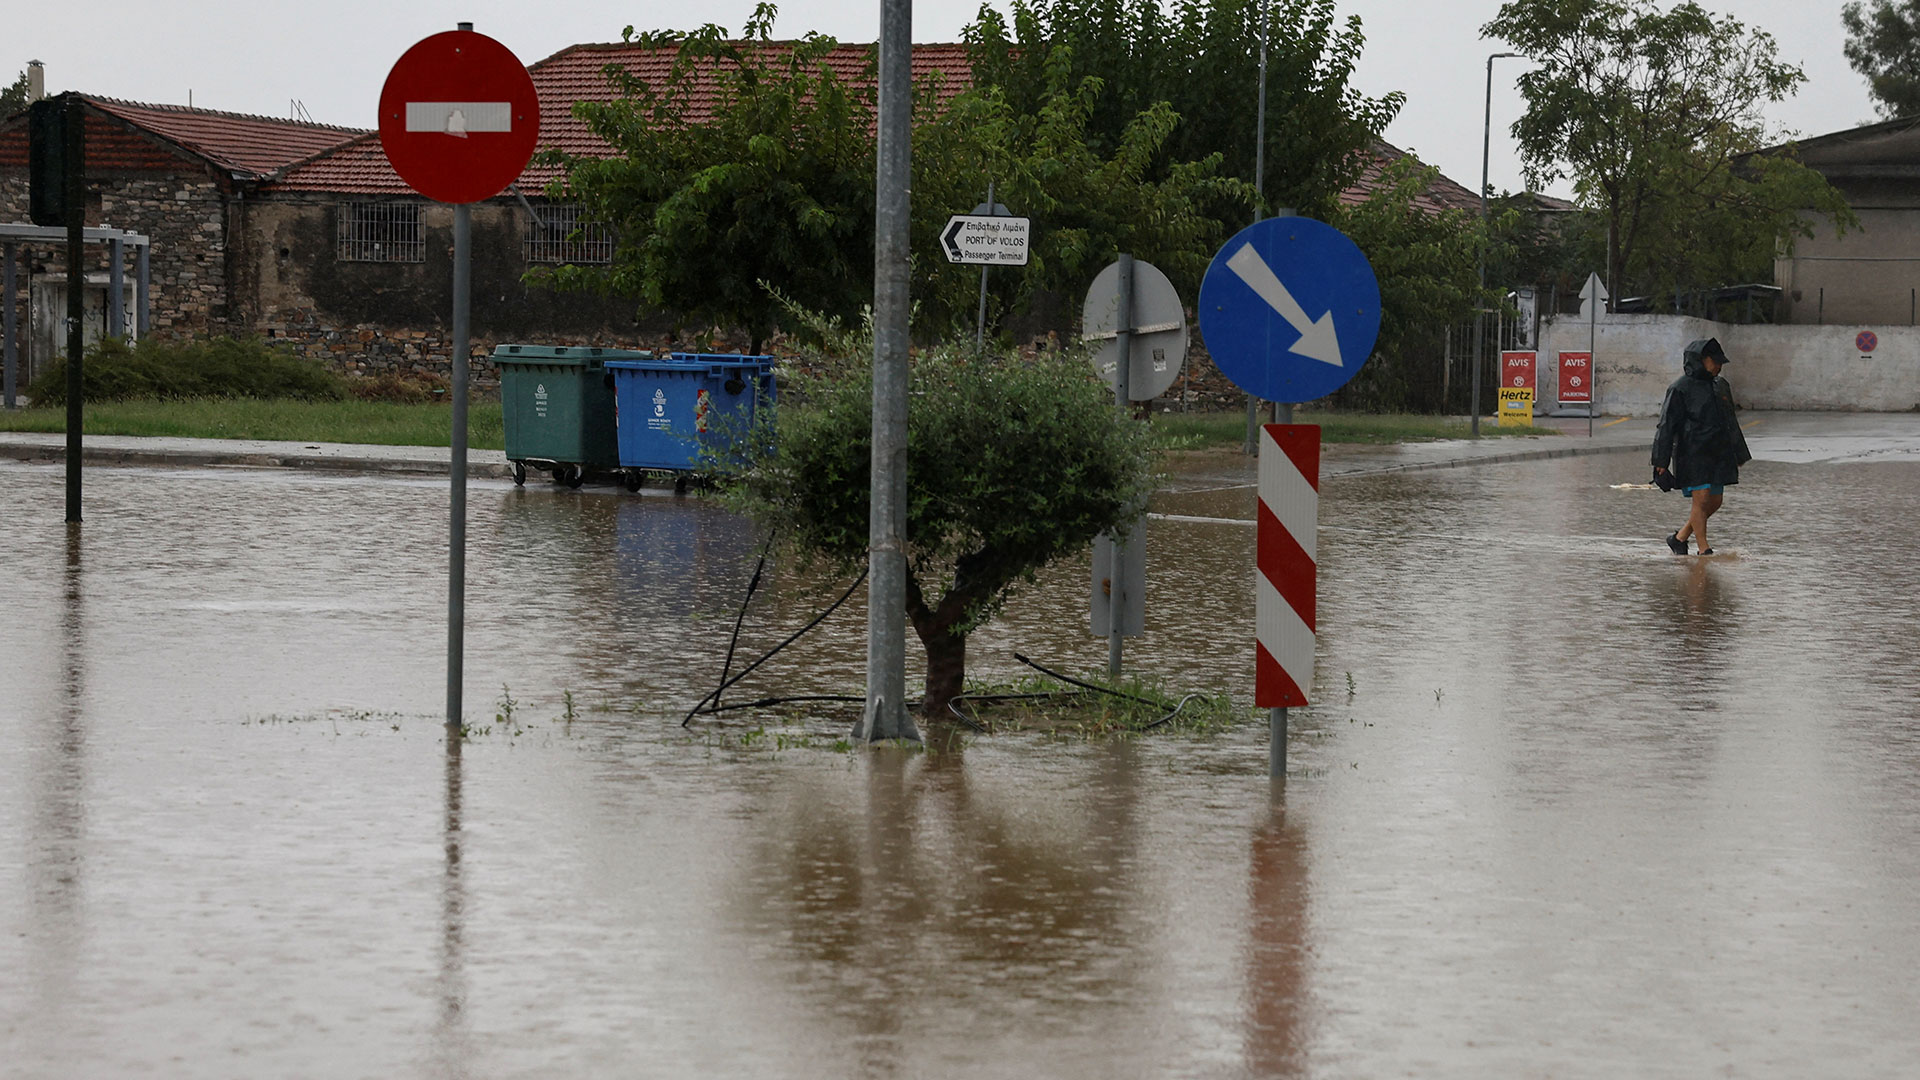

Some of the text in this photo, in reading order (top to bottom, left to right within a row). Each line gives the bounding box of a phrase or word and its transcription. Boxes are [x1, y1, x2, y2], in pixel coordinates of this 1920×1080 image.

[966, 221, 1025, 233] Επιβατικό Λιμάνι
[965, 236, 1024, 246] PORT OF VOLOS
[965, 250, 1023, 260] Passenger Terminal
[1508, 358, 1529, 367] AVIS
[1564, 358, 1586, 367] AVIS
[1500, 390, 1531, 400] Hertz
